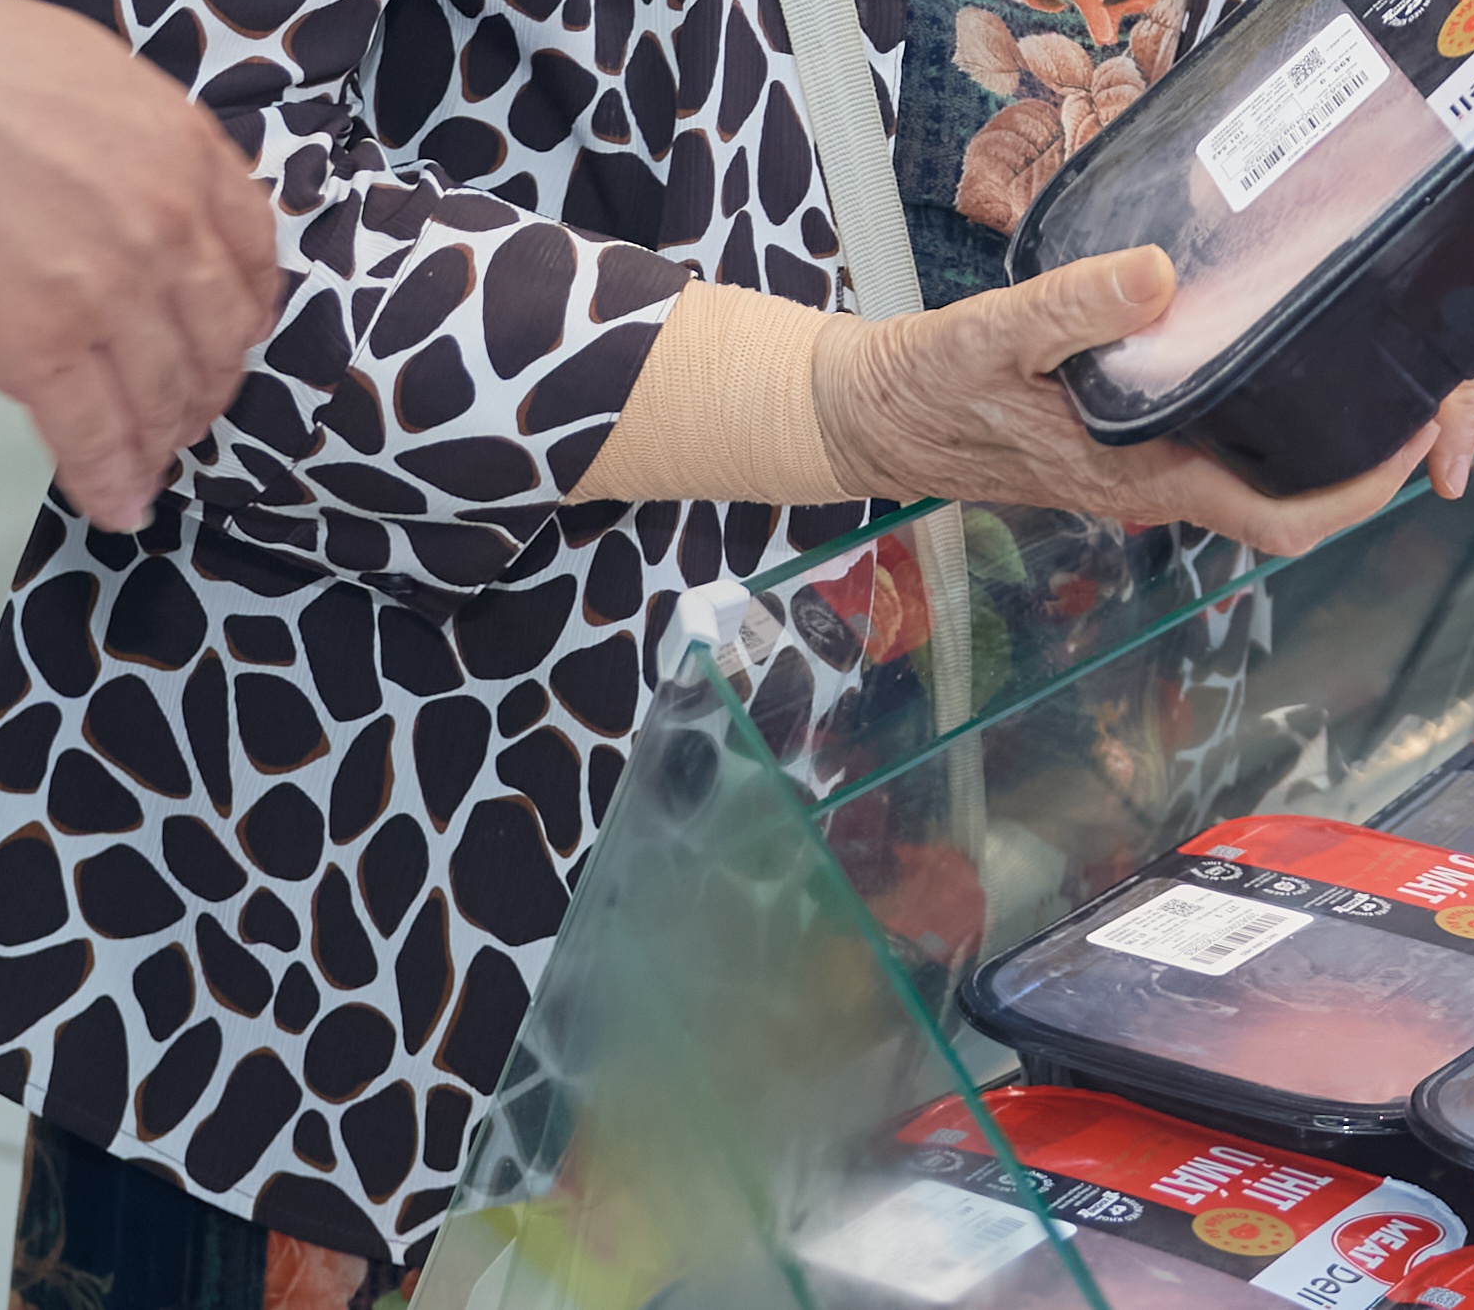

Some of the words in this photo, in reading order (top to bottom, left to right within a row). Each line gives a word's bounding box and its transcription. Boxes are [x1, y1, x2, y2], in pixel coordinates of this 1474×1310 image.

[1209, 1145, 1274, 1168] Ủ
[1150, 1156, 1244, 1205] MÁT
[1242, 1165, 1334, 1211] THỊT
[1348, 1219, 1423, 1270] MEAT
[1296, 1263, 1366, 1309] Deli
